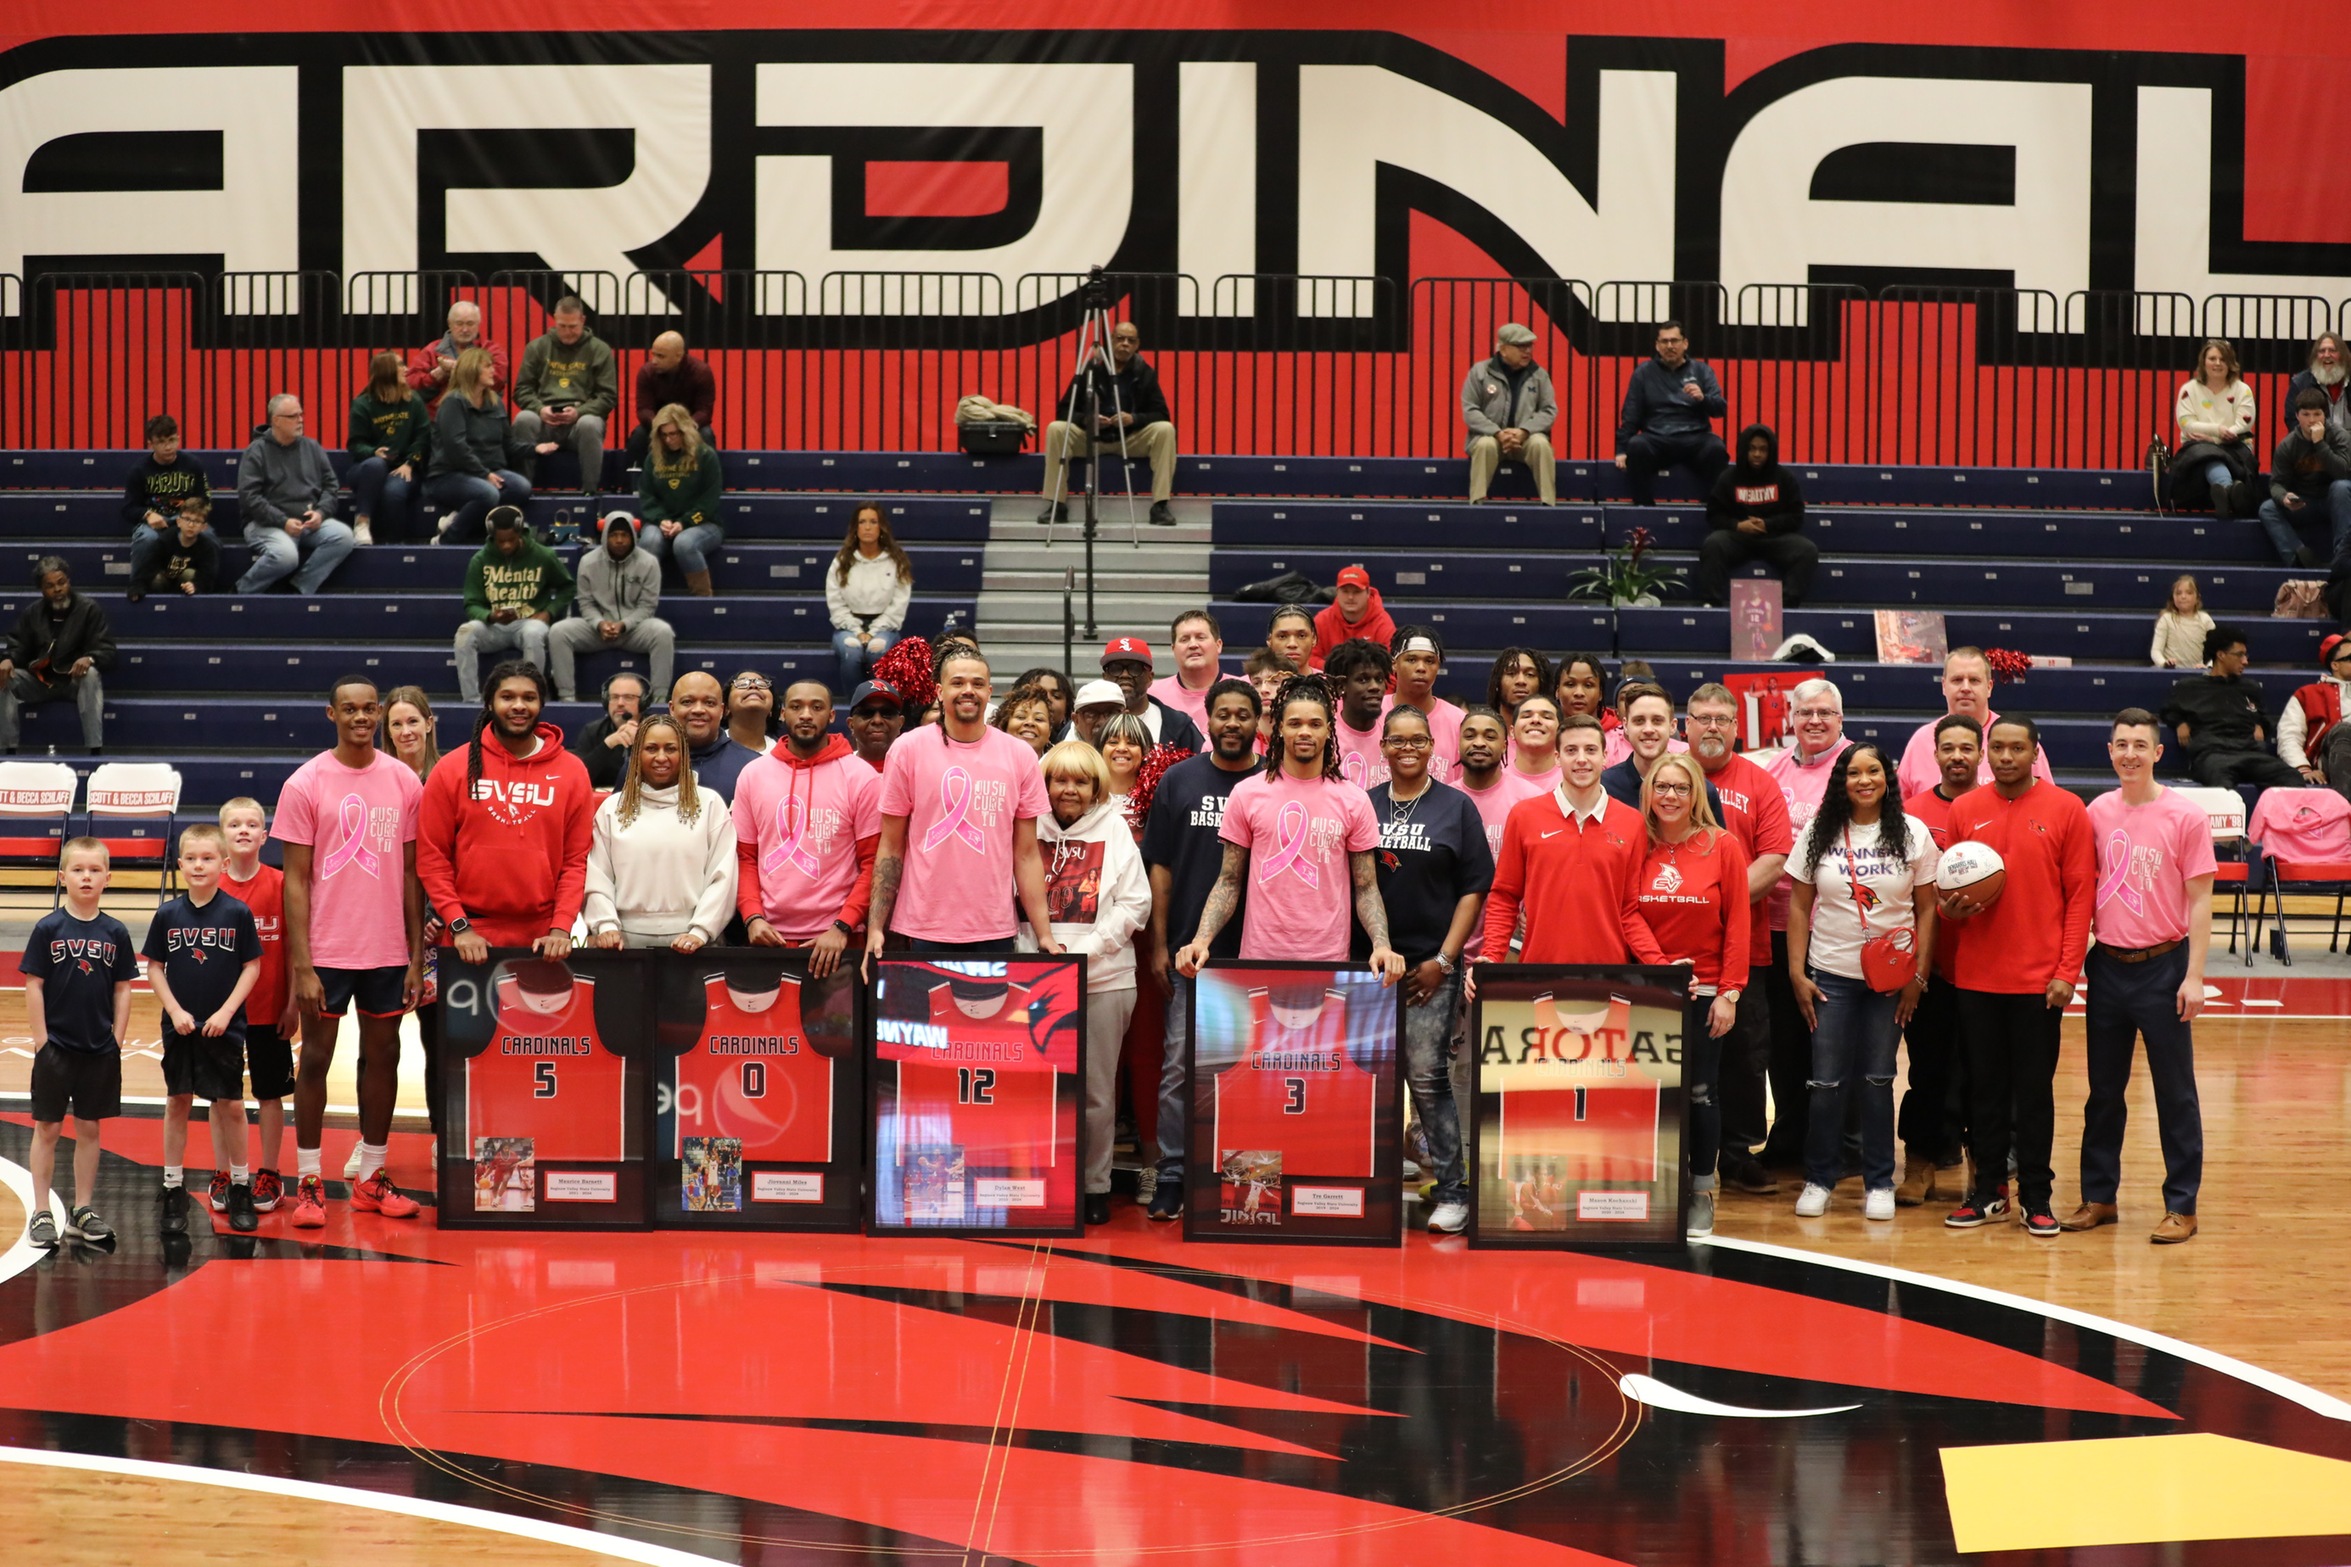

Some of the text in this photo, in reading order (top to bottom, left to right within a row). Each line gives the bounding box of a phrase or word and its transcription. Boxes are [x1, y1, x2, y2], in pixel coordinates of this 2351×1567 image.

[1736, 486, 1775, 502] WEALTHY
[483, 565, 542, 584] Mental
[486, 582, 539, 602] health
[472, 779, 555, 807] SVSU
[1715, 787, 1750, 815] ALLEY
[1378, 823, 1426, 837] VSU
[1376, 835, 1432, 852] KETBALL
[1838, 863, 1893, 877] WORK
[167, 928, 236, 953] SVSU
[50, 938, 117, 968] SVSU
[501, 1035, 592, 1056] CARDINALS
[708, 1035, 800, 1056] CARDINALS
[931, 1041, 1024, 1063] CARDINALS
[1250, 1050, 1342, 1073] CARDINALS
[1535, 1056, 1627, 1079] CARDINALS
[534, 1061, 557, 1099] 5
[741, 1061, 766, 1099] 0
[957, 1066, 996, 1105] 12
[1283, 1077, 1306, 1115] 3
[1574, 1084, 1587, 1121] 1
